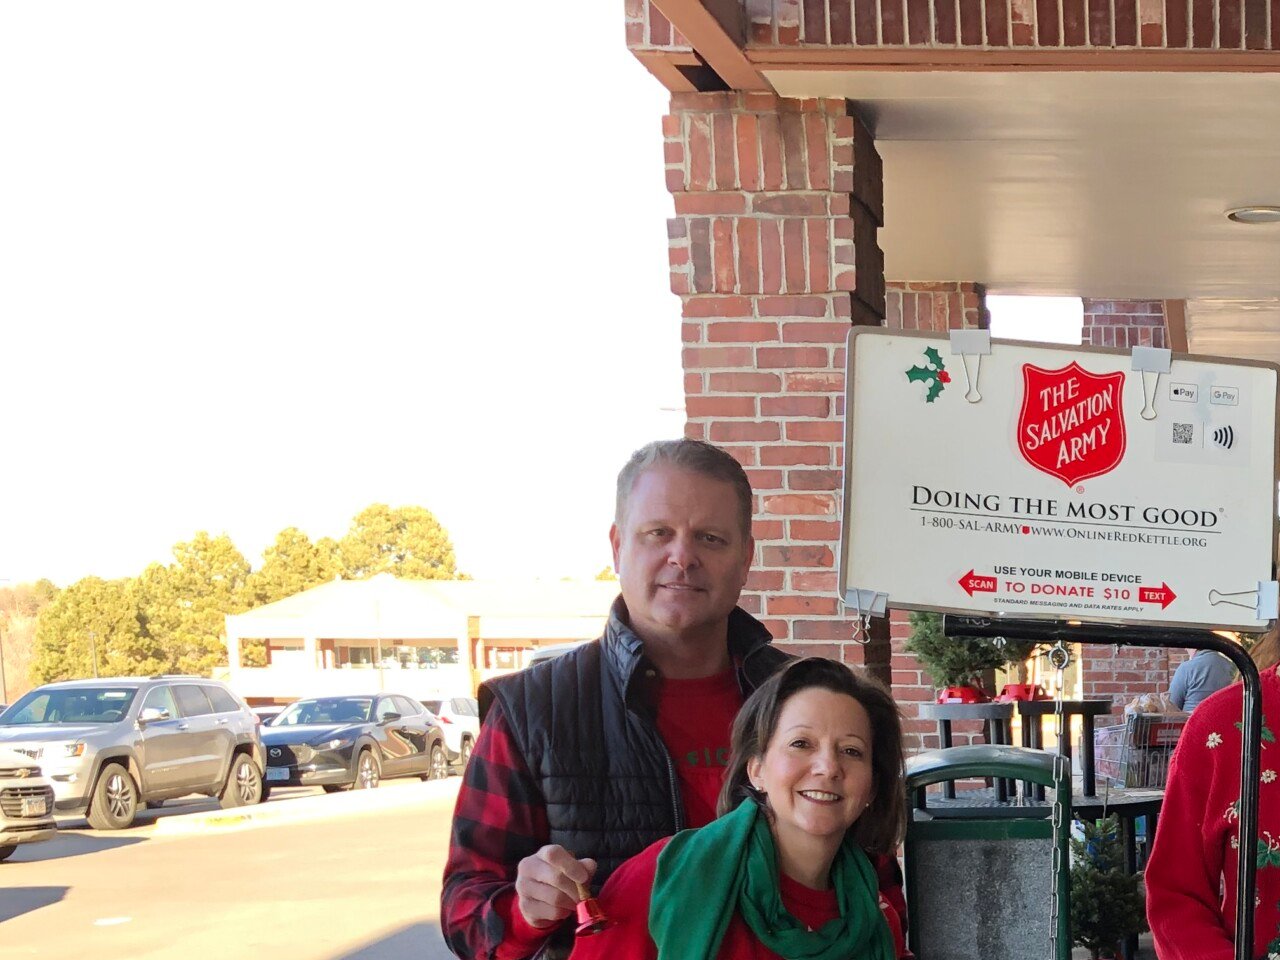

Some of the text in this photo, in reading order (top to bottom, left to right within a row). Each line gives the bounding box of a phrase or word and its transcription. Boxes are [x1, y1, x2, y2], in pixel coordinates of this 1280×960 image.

[1040, 377, 1080, 412] THE
[1180, 388, 1194, 398] Pay
[1222, 392, 1235, 401] Pay
[1026, 384, 1113, 450] SALVATION
[1056, 418, 1111, 469] ARMY
[912, 485, 1218, 527] DOING THE MOST GOOD
[921, 516, 1022, 535] 1-800-SAL-ARMY
[994, 566, 1142, 584] USE YOUR MOBILE DEVICE
[969, 580, 994, 589] SCAN
[1005, 581, 1130, 600] TO DONATE $10
[1030, 600, 1068, 608] MESSAGING
[1144, 591, 1166, 600] TEXT
